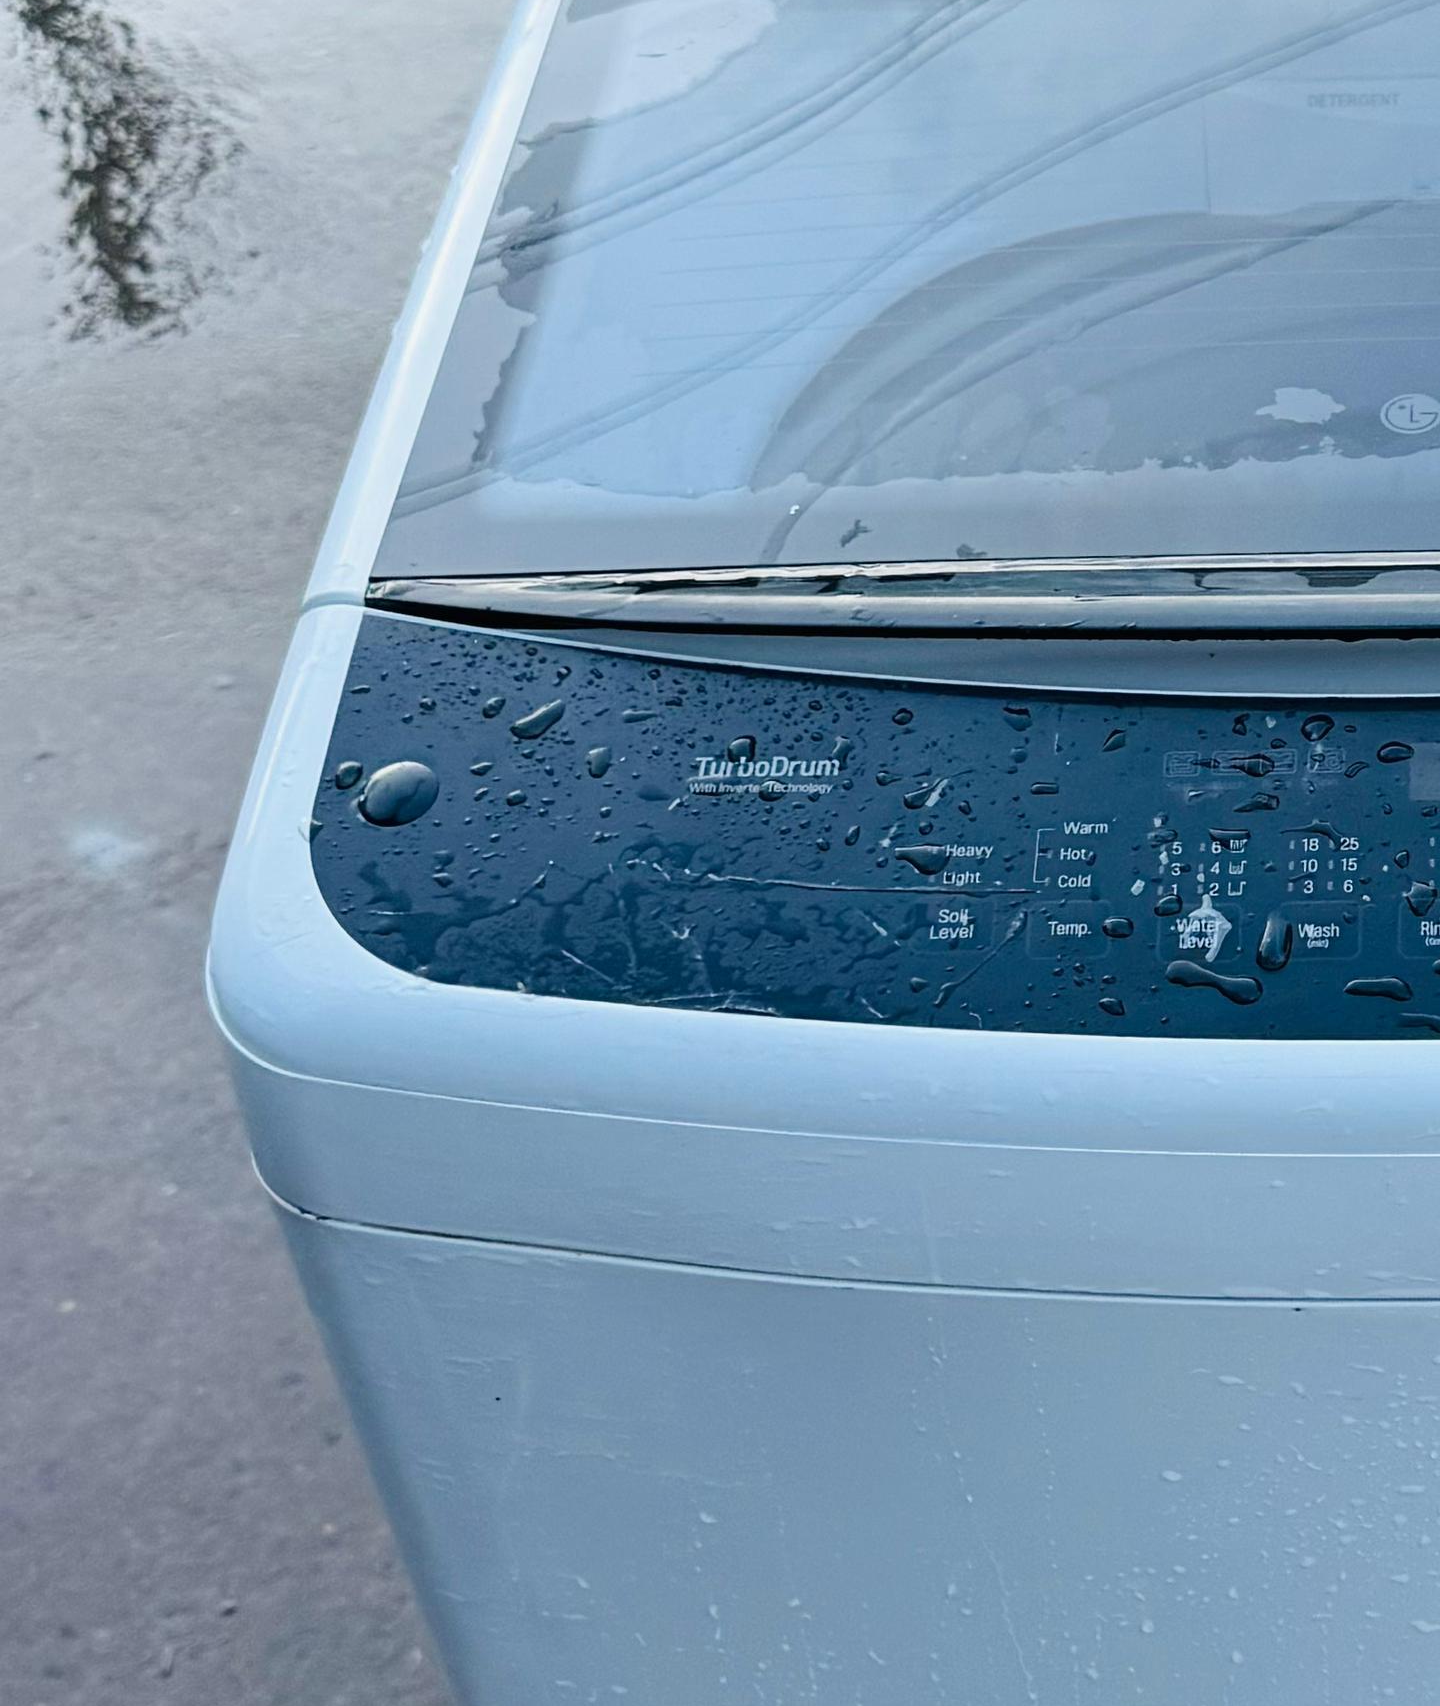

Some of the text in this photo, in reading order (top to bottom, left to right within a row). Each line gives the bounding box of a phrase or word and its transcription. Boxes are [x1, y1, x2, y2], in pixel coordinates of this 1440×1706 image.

[1307, 93, 1399, 108] DETERGENT
[696, 756, 840, 777] TurboDrum
[768, 782, 833, 794] Technology
[1064, 822, 1108, 834] Warm
[1172, 842, 1222, 854] 5 6
[1302, 837, 1359, 851] 18 25
[946, 845, 993, 859] Heavy
[1060, 848, 1086, 860] Hot
[1171, 863, 1220, 876] 3 4
[1301, 858, 1358, 872] 10 15
[943, 872, 981, 886] Light
[1058, 875, 1091, 887] Cold
[1171, 883, 1219, 896] 1 2
[1304, 880, 1353, 893] 3 6
[930, 925, 974, 939] Level
[1048, 922, 1092, 937] Temp.
[1298, 924, 1340, 938] Wash
